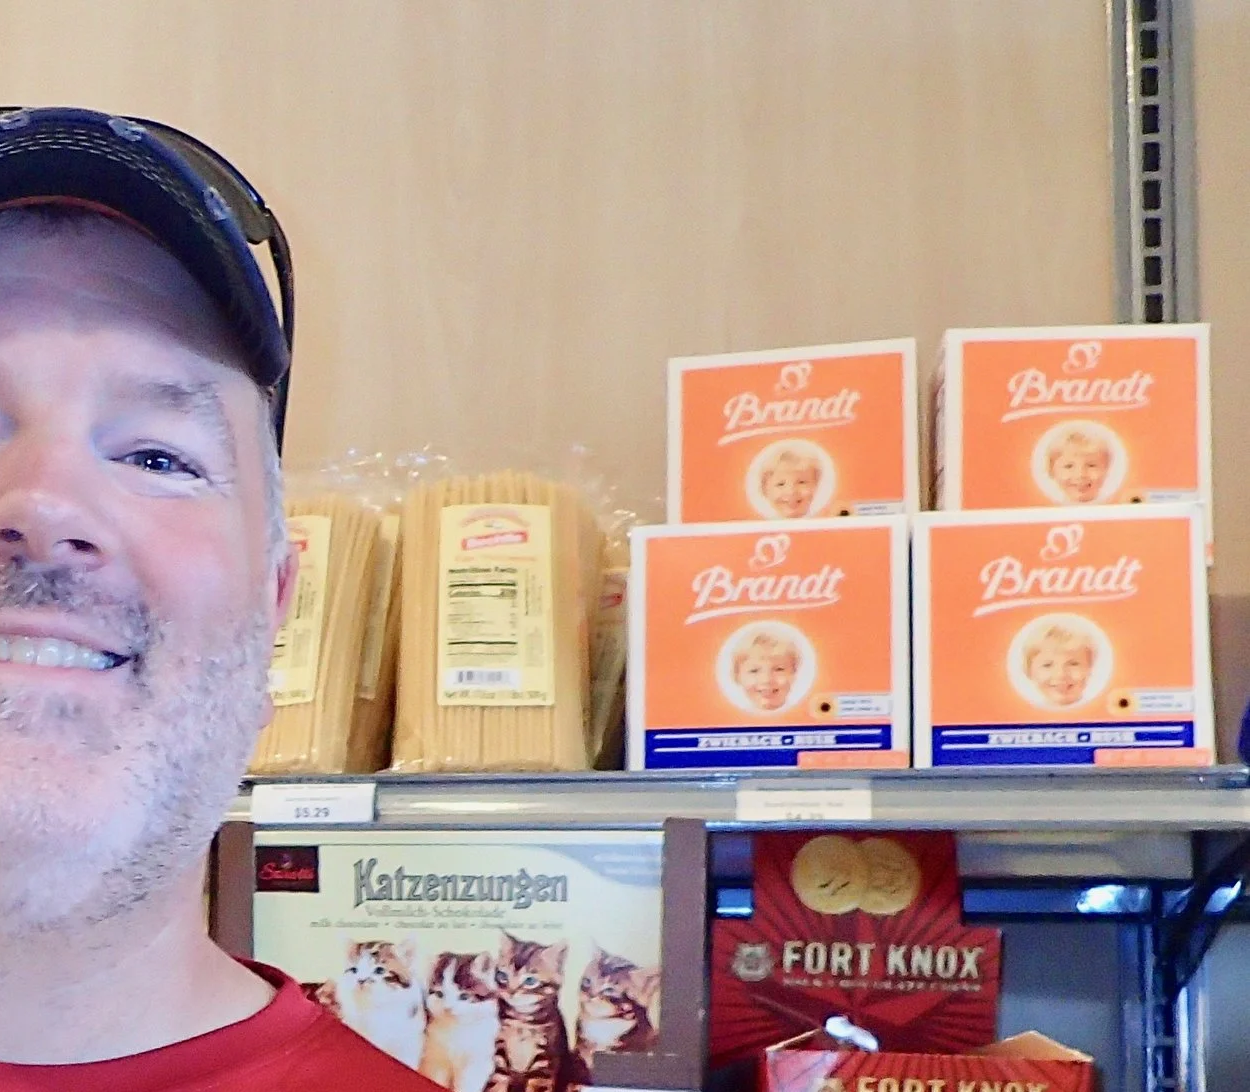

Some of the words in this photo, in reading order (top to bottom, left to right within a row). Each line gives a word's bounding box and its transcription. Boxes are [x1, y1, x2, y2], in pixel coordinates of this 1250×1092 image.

[1008, 368, 1153, 408] Brandt
[723, 389, 860, 431] Brandt
[692, 564, 845, 610] Brandt
[980, 555, 1142, 601] Brandt
[294, 807, 330, 819] $5.29
[353, 858, 568, 910] Katzenzungen
[782, 939, 875, 977] FORT
[886, 943, 983, 980] KNOX
